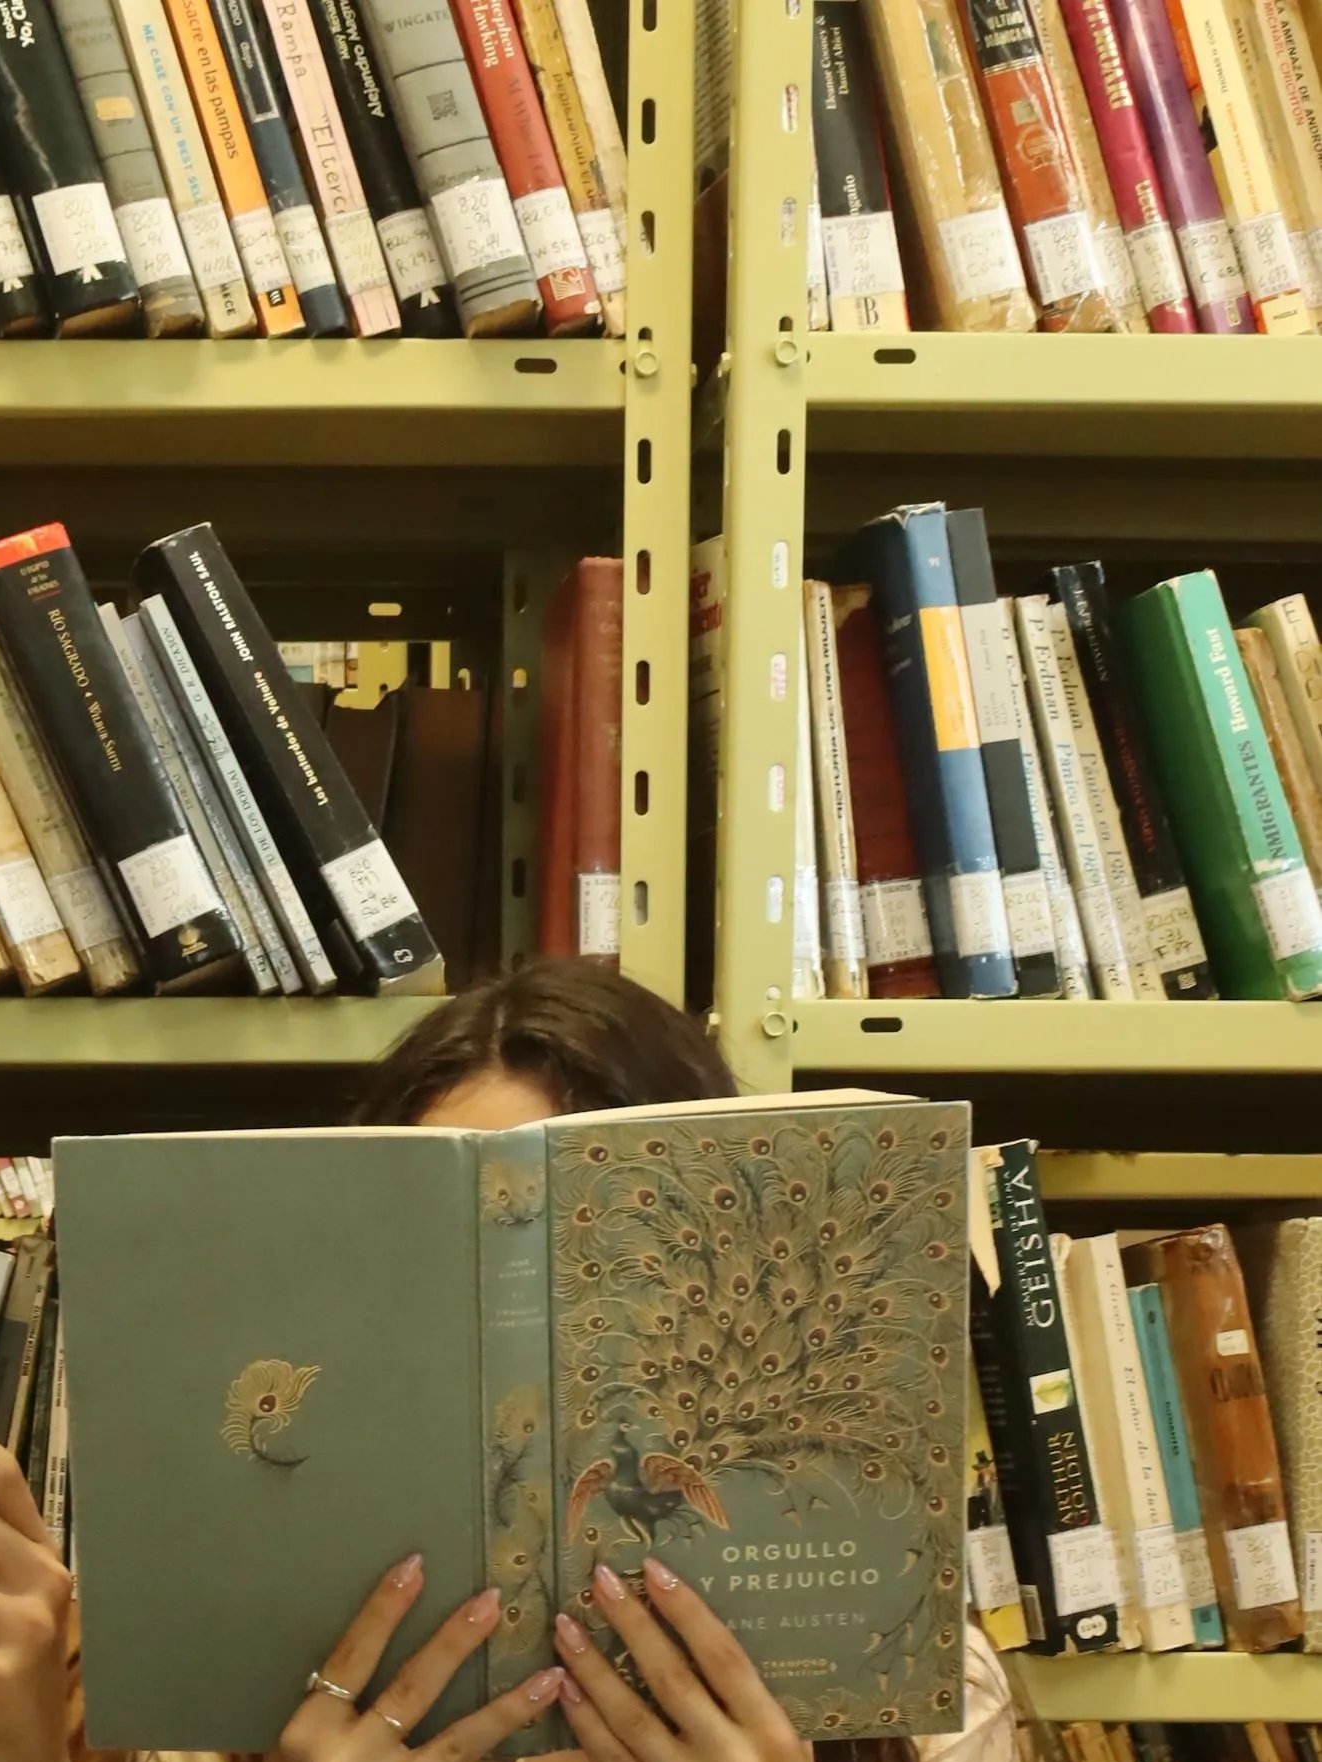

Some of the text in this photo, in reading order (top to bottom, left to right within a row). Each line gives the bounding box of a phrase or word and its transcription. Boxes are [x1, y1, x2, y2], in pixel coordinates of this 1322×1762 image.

[276, 3, 309, 79] Rampa
[1204, 19, 1230, 95] THOMAS COOK
[1279, 18, 1311, 105] AMENAZA DE
[141, 23, 195, 172] ME CASE CON UN BEST
[197, 45, 240, 161] en las pampas
[354, 44, 386, 119] Alejandro
[837, 63, 850, 96] Daniel
[1278, 60, 1305, 128] CRICHTON
[188, 549, 209, 583] SAUL
[205, 581, 238, 633] RALSTON
[230, 632, 256, 664] JOHN
[1204, 625, 1250, 735] Howard Fast
[47, 606, 124, 774] RÍO SAGRADO WILBUR SMITH
[253, 669, 281, 713] Voltaire
[1057, 655, 1083, 730] Erdman
[285, 727, 319, 786] bastardos
[1034, 644, 1060, 722] Erdman
[1072, 812, 1086, 835] en
[227, 768, 252, 810] DORSAI
[312, 782, 330, 808] Los
[1002, 1169, 1016, 1206] UNA
[1009, 1164, 1056, 1329] GEISHA
[1013, 1236, 1035, 1327] MEMORIAS
[1046, 1431, 1072, 1526] ARTHUR
[1060, 1430, 1091, 1527] GOLDEN
[1136, 1439, 1150, 1458] de
[699, 1567, 880, 1593] Y PREJUICIO
[721, 1540, 858, 1564] ORGULLO
[778, 1611, 867, 1629] AUSTEN
